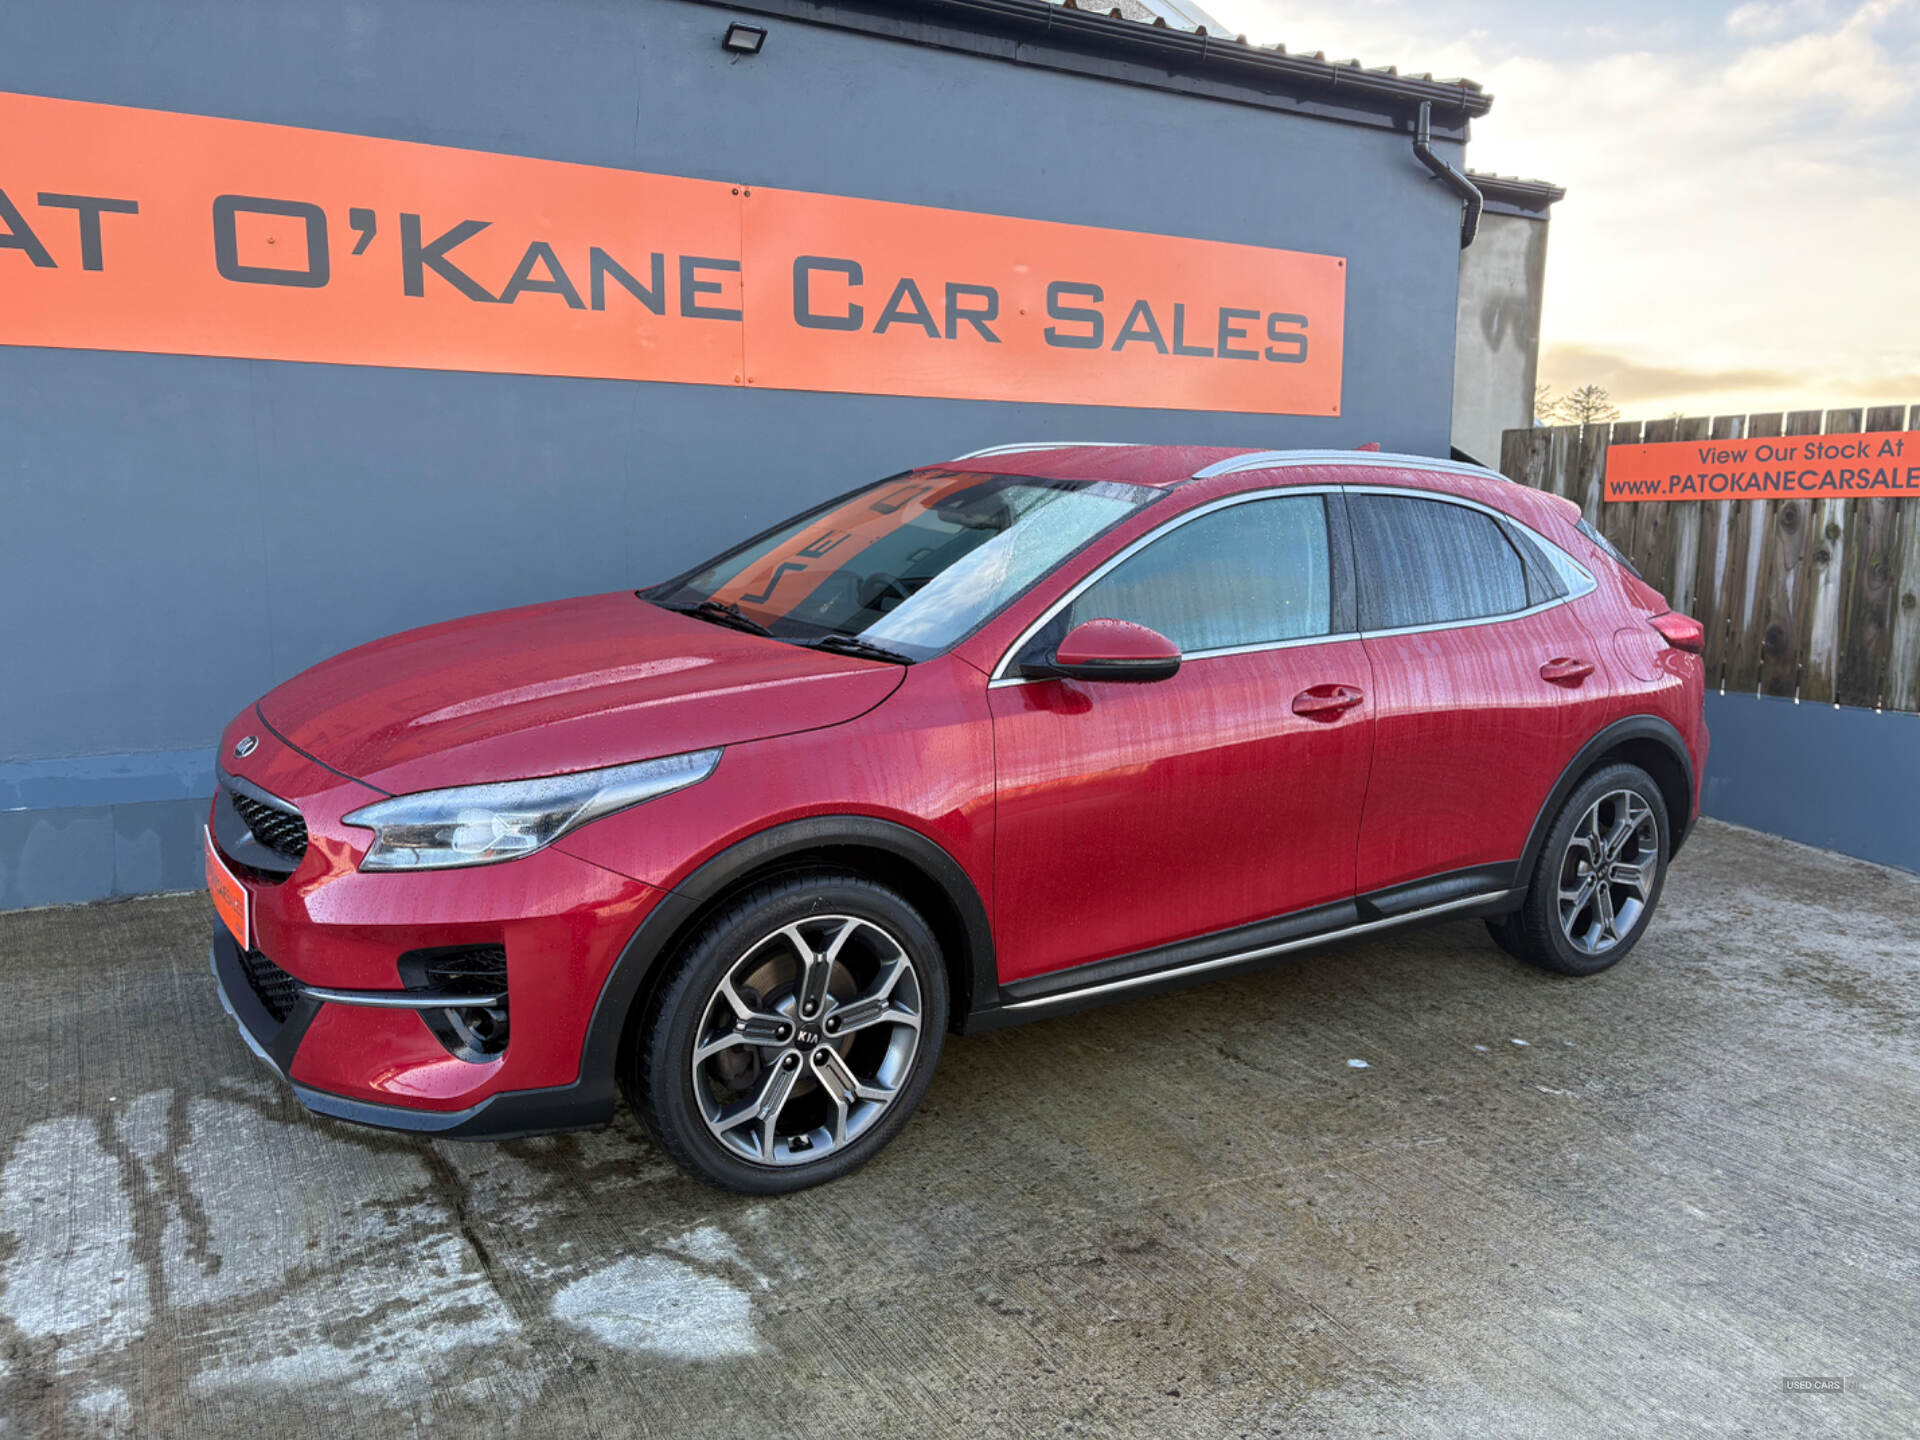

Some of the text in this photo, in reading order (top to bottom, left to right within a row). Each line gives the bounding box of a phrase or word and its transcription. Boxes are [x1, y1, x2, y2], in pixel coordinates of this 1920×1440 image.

[212, 194, 743, 322] O'KANE
[793, 255, 1002, 343] CAR
[1044, 280, 1308, 363] SALES
[1698, 439, 1904, 465] View Our Stock At
[797, 1030, 818, 1044] KIA
